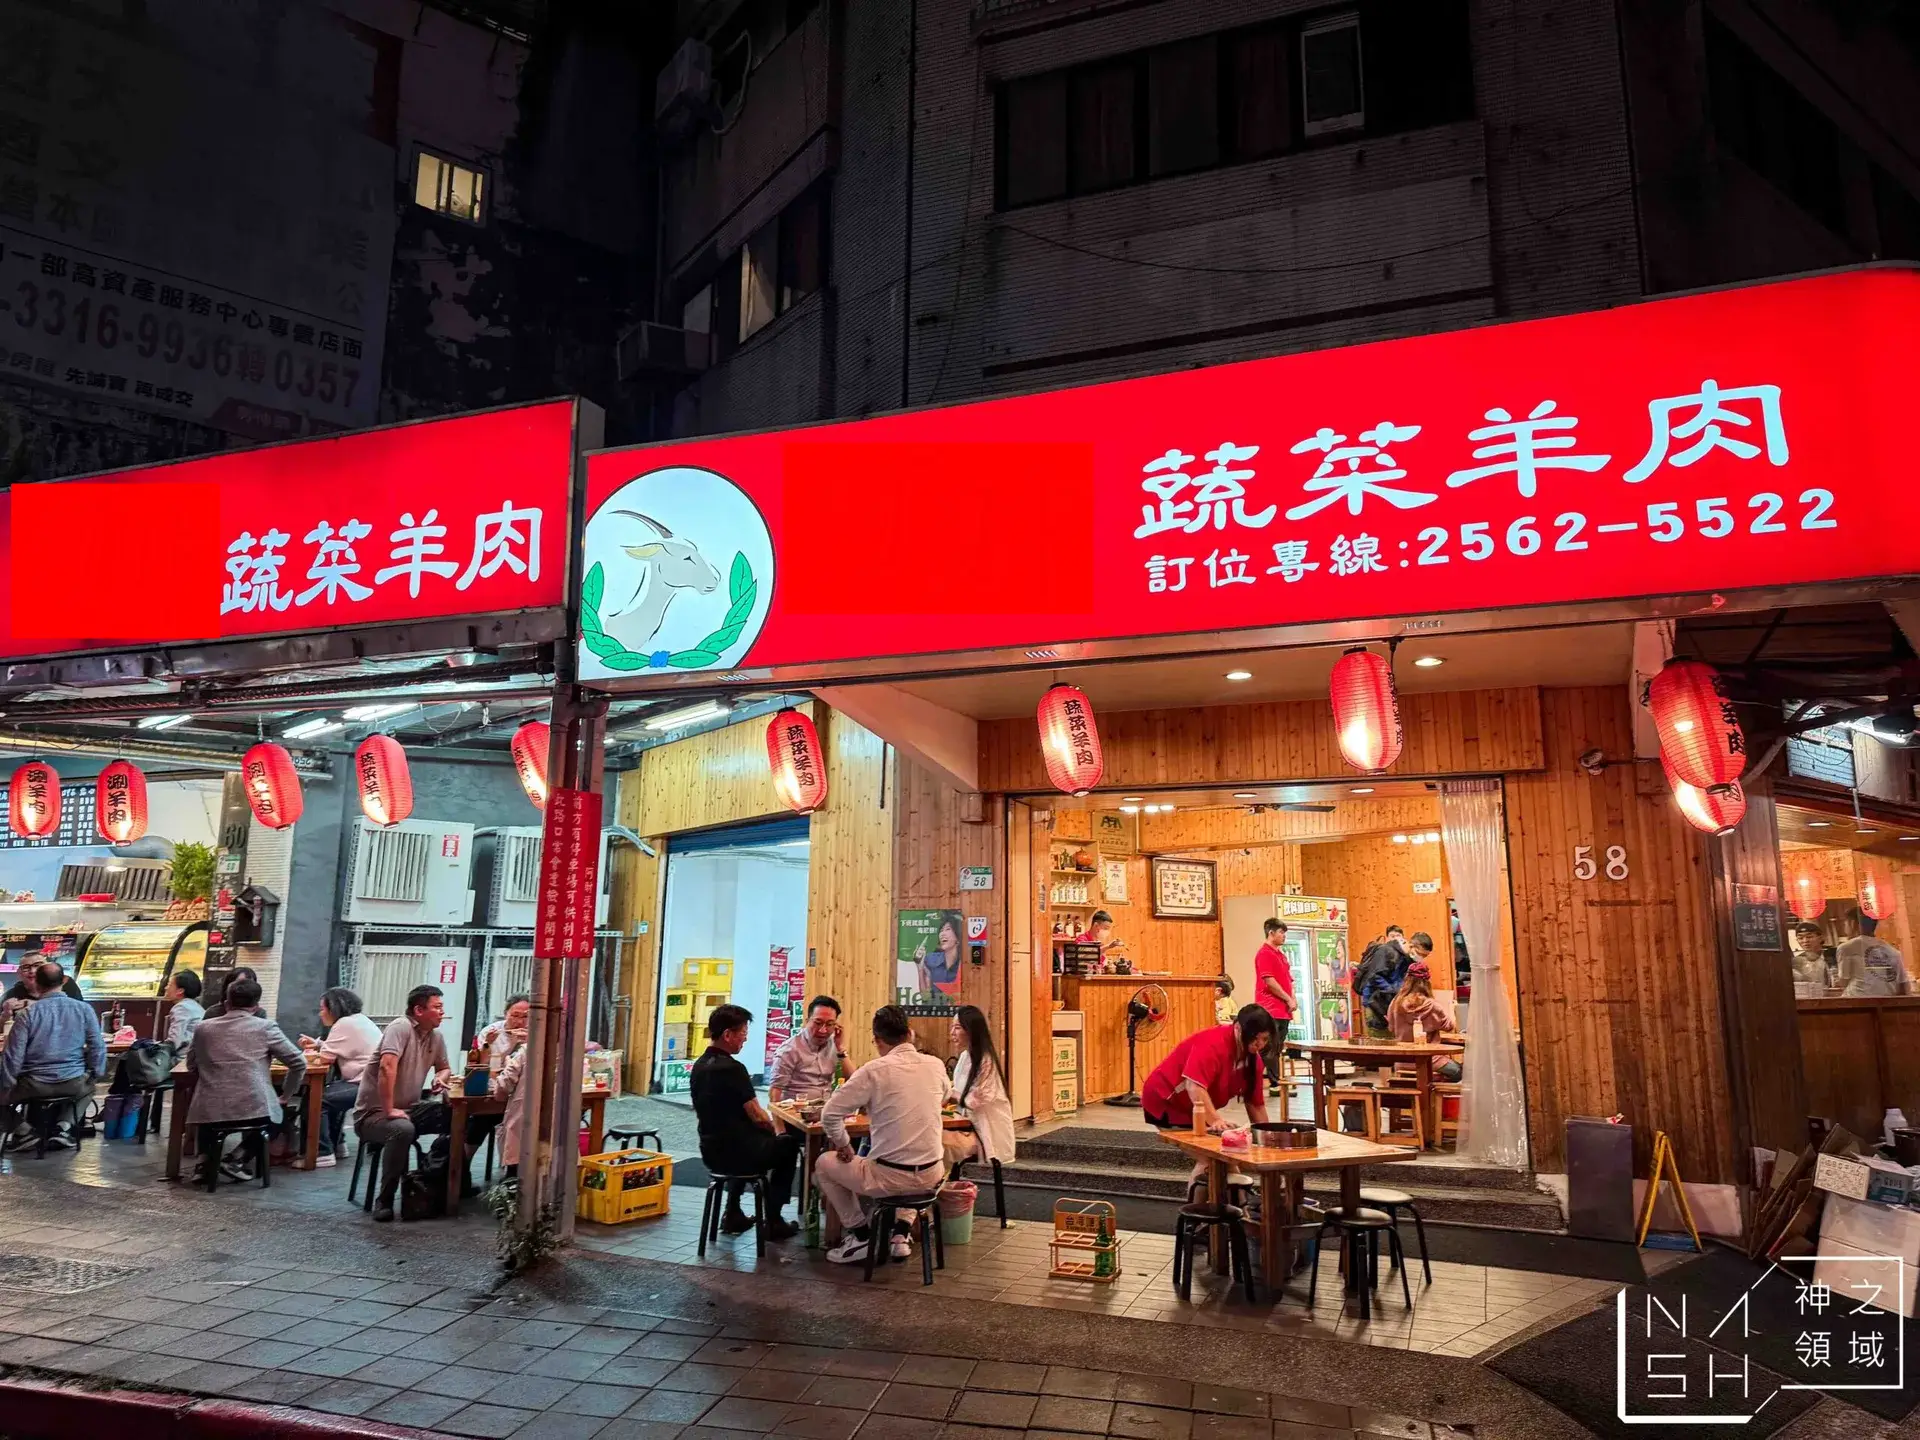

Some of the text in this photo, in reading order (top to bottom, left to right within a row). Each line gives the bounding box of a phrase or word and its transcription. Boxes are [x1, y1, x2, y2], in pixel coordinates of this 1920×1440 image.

[1133, 378, 1790, 540] 蔬菜羊肉
[220, 500, 544, 616] 蔬菜羊肉
[786, 724, 816, 787] 蔬菜羊肉
[1062, 699, 1095, 766] 蔬菜羊肉
[107, 775, 129, 825] 涮羊肉
[974, 876, 987, 887] 58
[1574, 845, 1629, 881] 58
